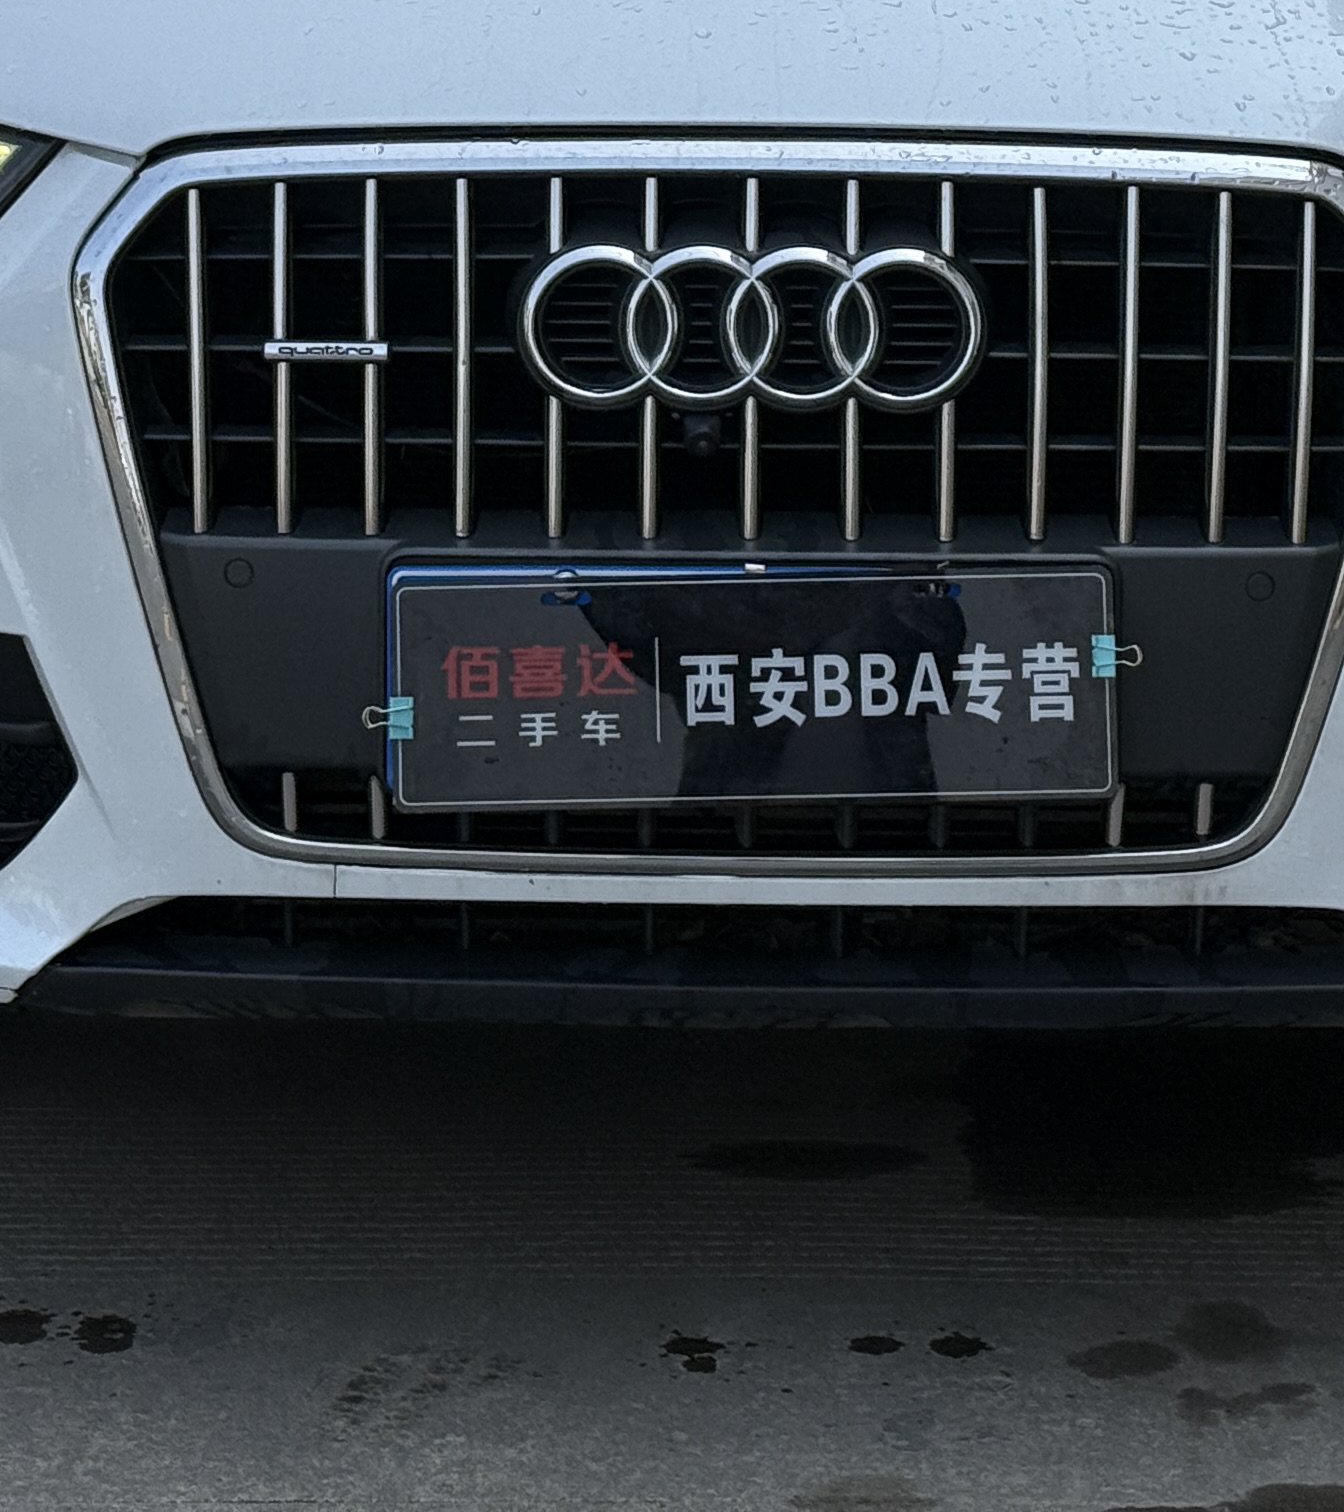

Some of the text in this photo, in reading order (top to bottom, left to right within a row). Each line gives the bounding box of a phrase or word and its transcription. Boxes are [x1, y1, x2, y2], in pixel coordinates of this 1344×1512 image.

[278, 345, 374, 357] quattro
[441, 642, 638, 700] 佰喜达
[679, 642, 1081, 728] 西安BBA专营
[456, 710, 622, 748] 二手车
